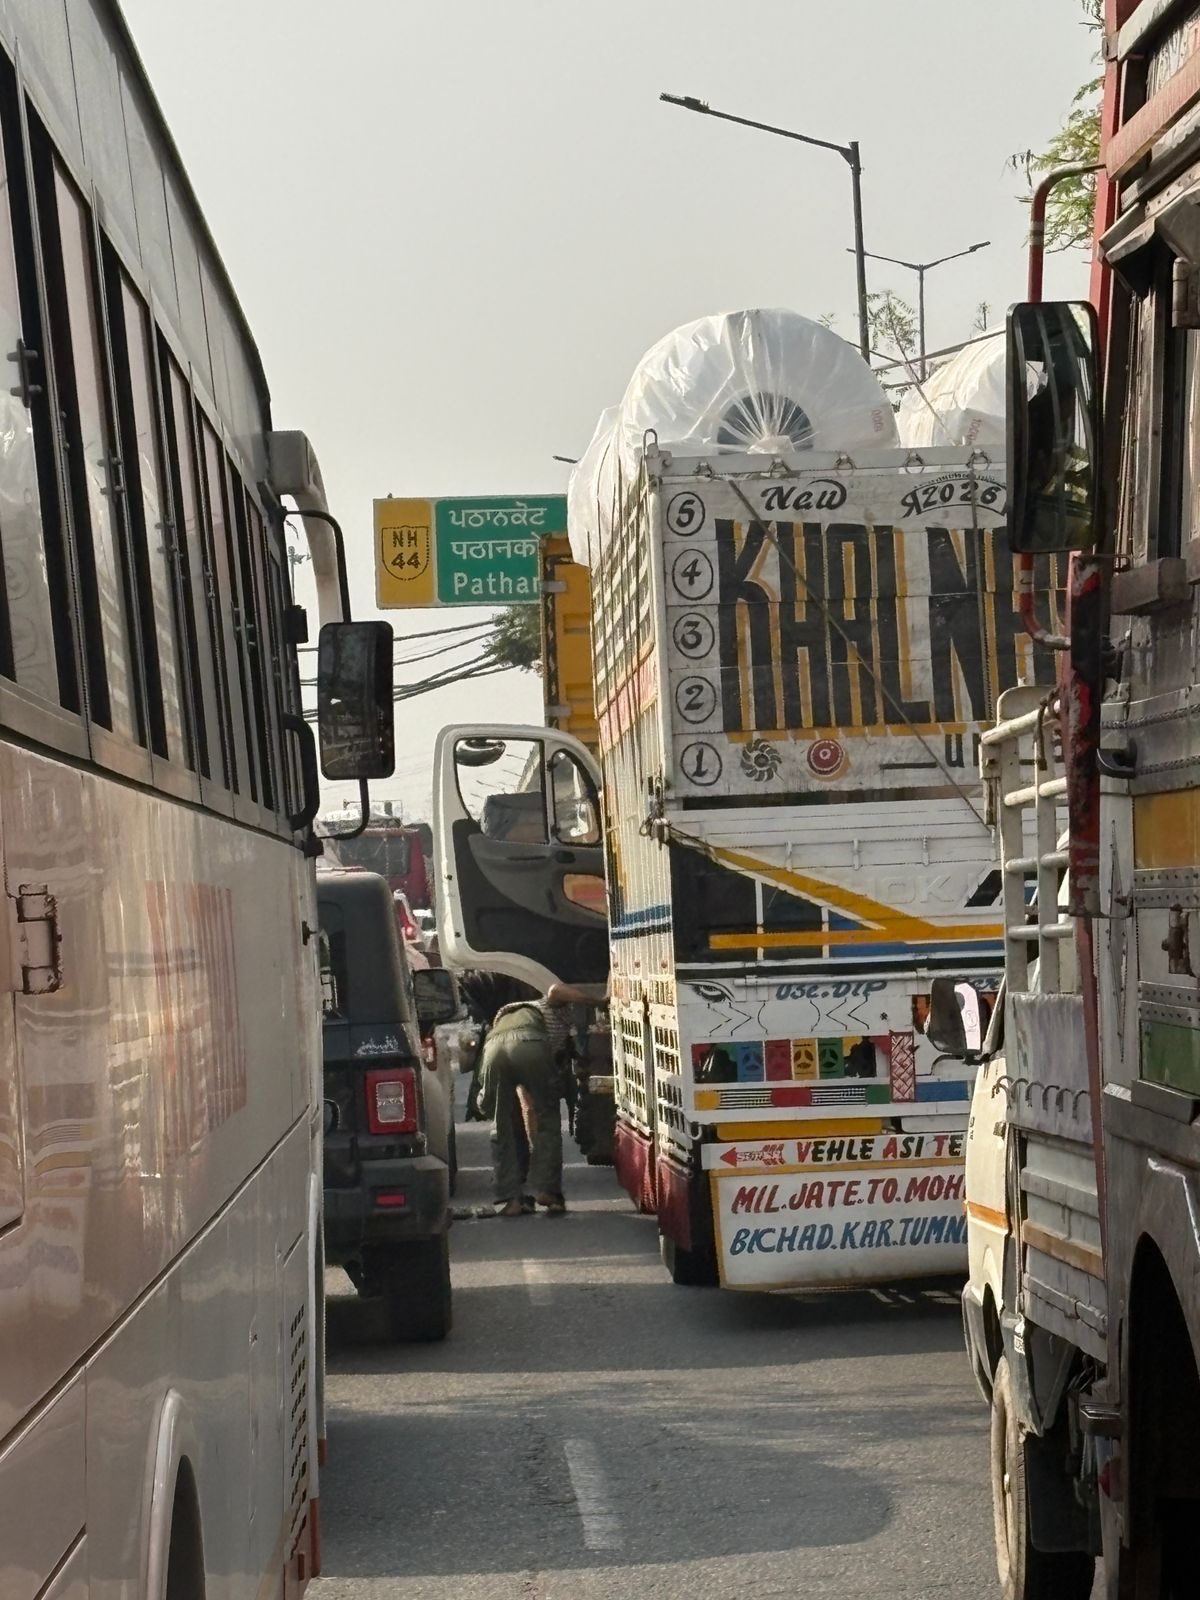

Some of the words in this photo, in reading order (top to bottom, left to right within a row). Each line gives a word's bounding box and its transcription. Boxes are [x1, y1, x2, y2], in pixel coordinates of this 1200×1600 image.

[761, 479, 847, 511] New
[676, 499, 695, 528] 5
[392, 530, 418, 548] NH
[391, 552, 421, 569] 44
[681, 558, 701, 586] 4
[680, 621, 702, 650] 3
[684, 684, 704, 711] 2
[692, 748, 708, 777] 1
[796, 1138, 875, 1163] VEHLE
[882, 1136, 925, 1160] ASI
